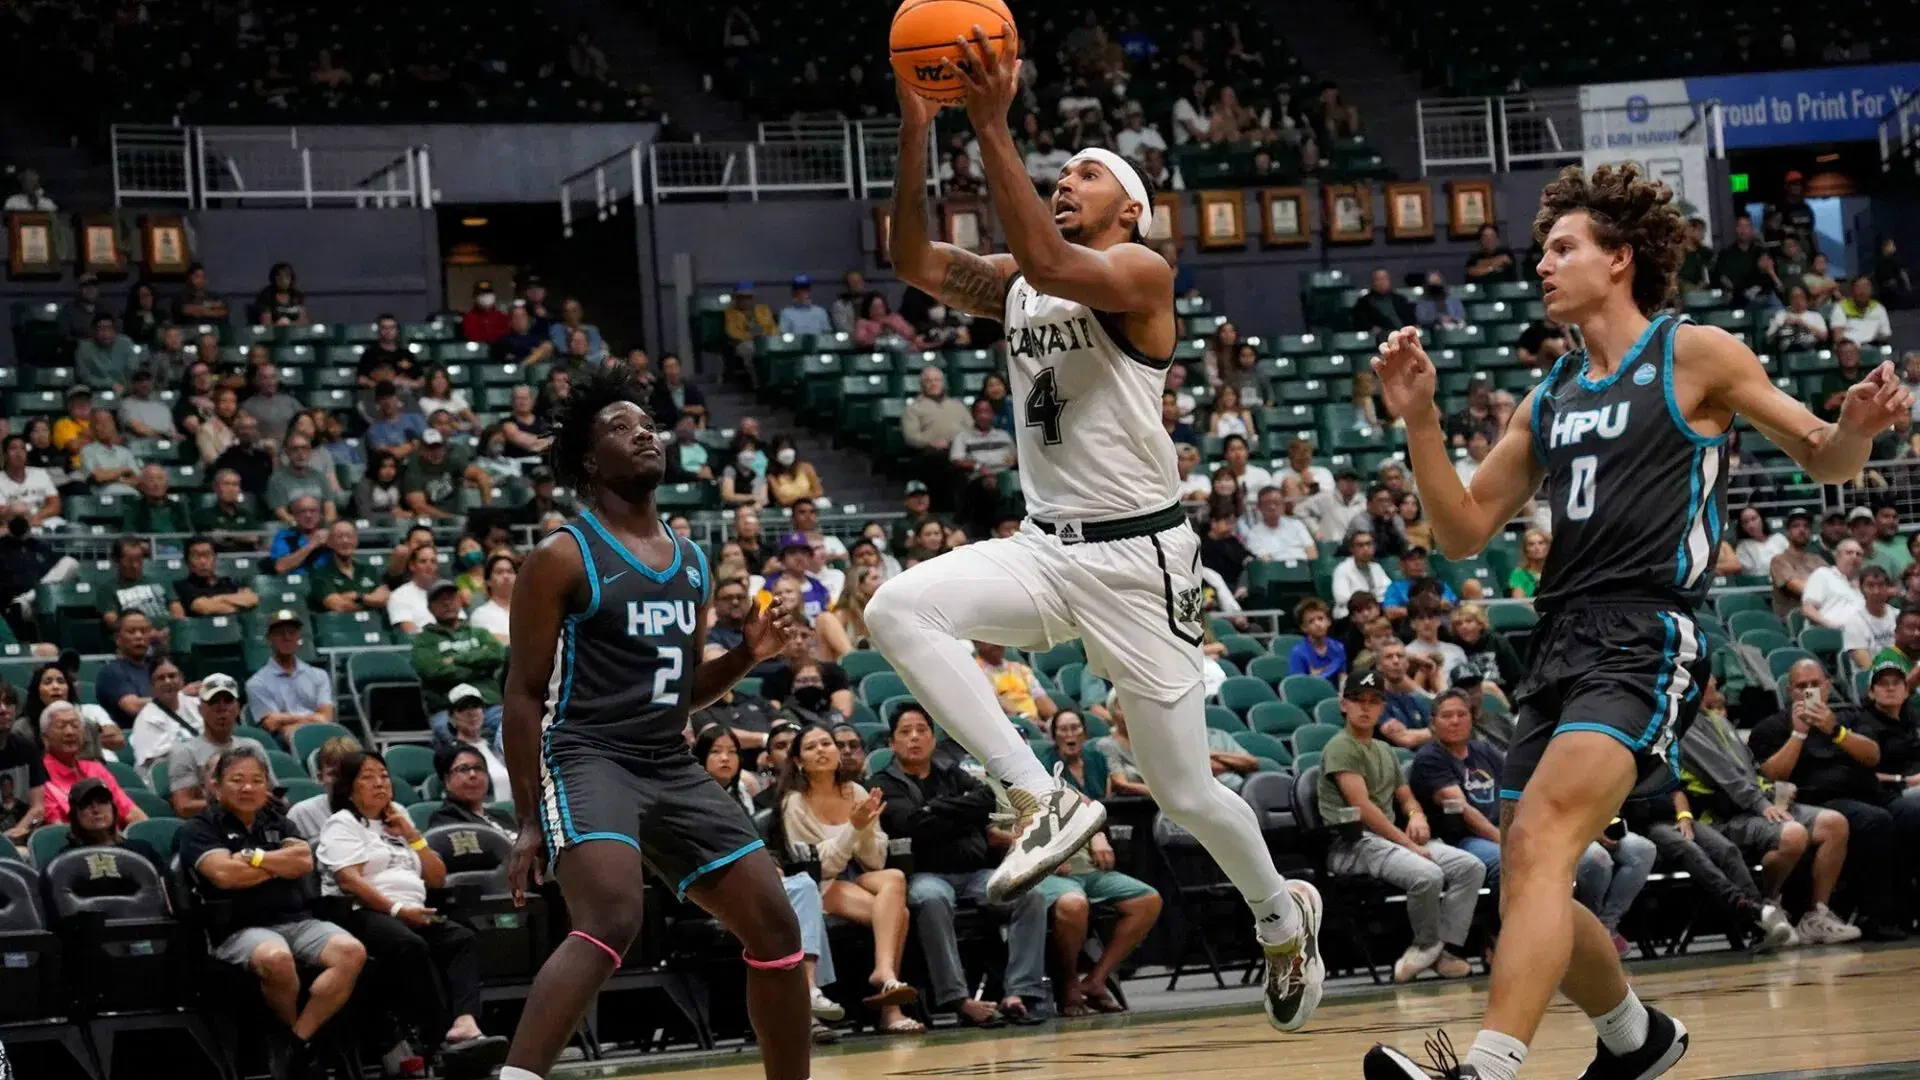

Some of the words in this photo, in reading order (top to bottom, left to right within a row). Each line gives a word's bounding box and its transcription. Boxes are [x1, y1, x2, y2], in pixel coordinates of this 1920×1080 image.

[1714, 95, 1767, 128] roud
[1772, 97, 1792, 125] to
[1797, 91, 1849, 122] Print
[1852, 88, 1885, 119] For
[1025, 366, 1069, 446] 4
[1550, 401, 1631, 449] HPU
[1567, 455, 1598, 520] 0
[627, 600, 696, 636] HPU
[651, 646, 683, 706] 2
